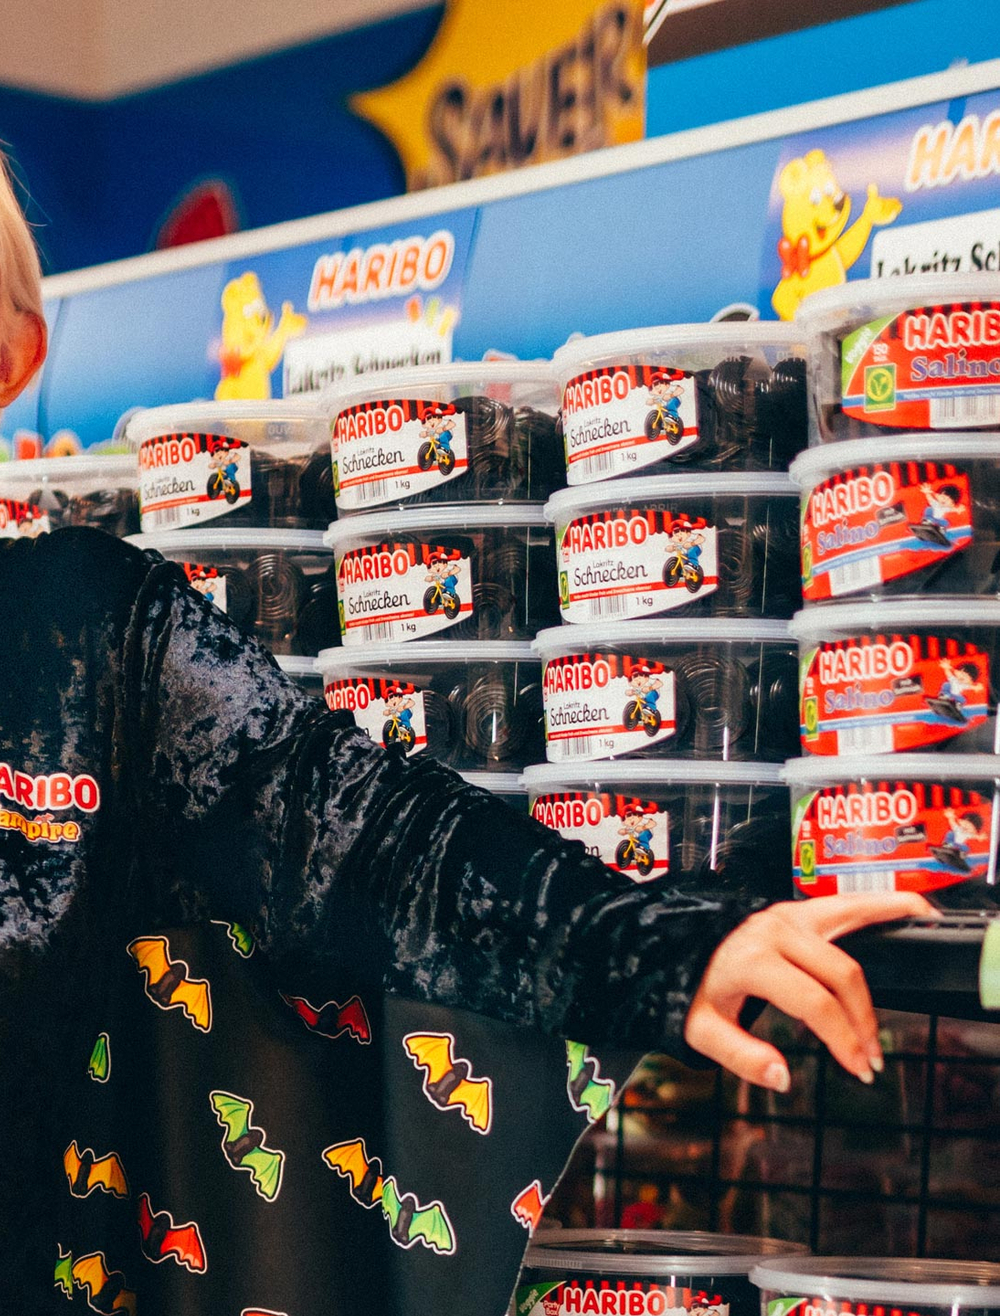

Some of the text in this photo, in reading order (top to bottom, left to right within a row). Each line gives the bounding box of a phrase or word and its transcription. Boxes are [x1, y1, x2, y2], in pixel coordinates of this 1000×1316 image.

[311, 234, 451, 308] HARIBO
[566, 373, 630, 414] HARIBO
[338, 407, 404, 443] HARIBO
[570, 418, 631, 449] Schnecken
[141, 440, 196, 469] HARIBO
[342, 448, 405, 475] Schnecken
[813, 472, 894, 526] HARIBO
[571, 517, 648, 554] HARIBO
[344, 550, 409, 585] HARIBO
[573, 561, 649, 588] Schnecken
[348, 590, 411, 616] Schnecken
[548, 660, 610, 695] HARIBO
[821, 643, 912, 684] HARIBO
[550, 702, 610, 727] Schnecken
[535, 800, 602, 829] HARIBO
[819, 790, 917, 829] HARIBO
[565, 1288, 667, 1316] HARIBO
